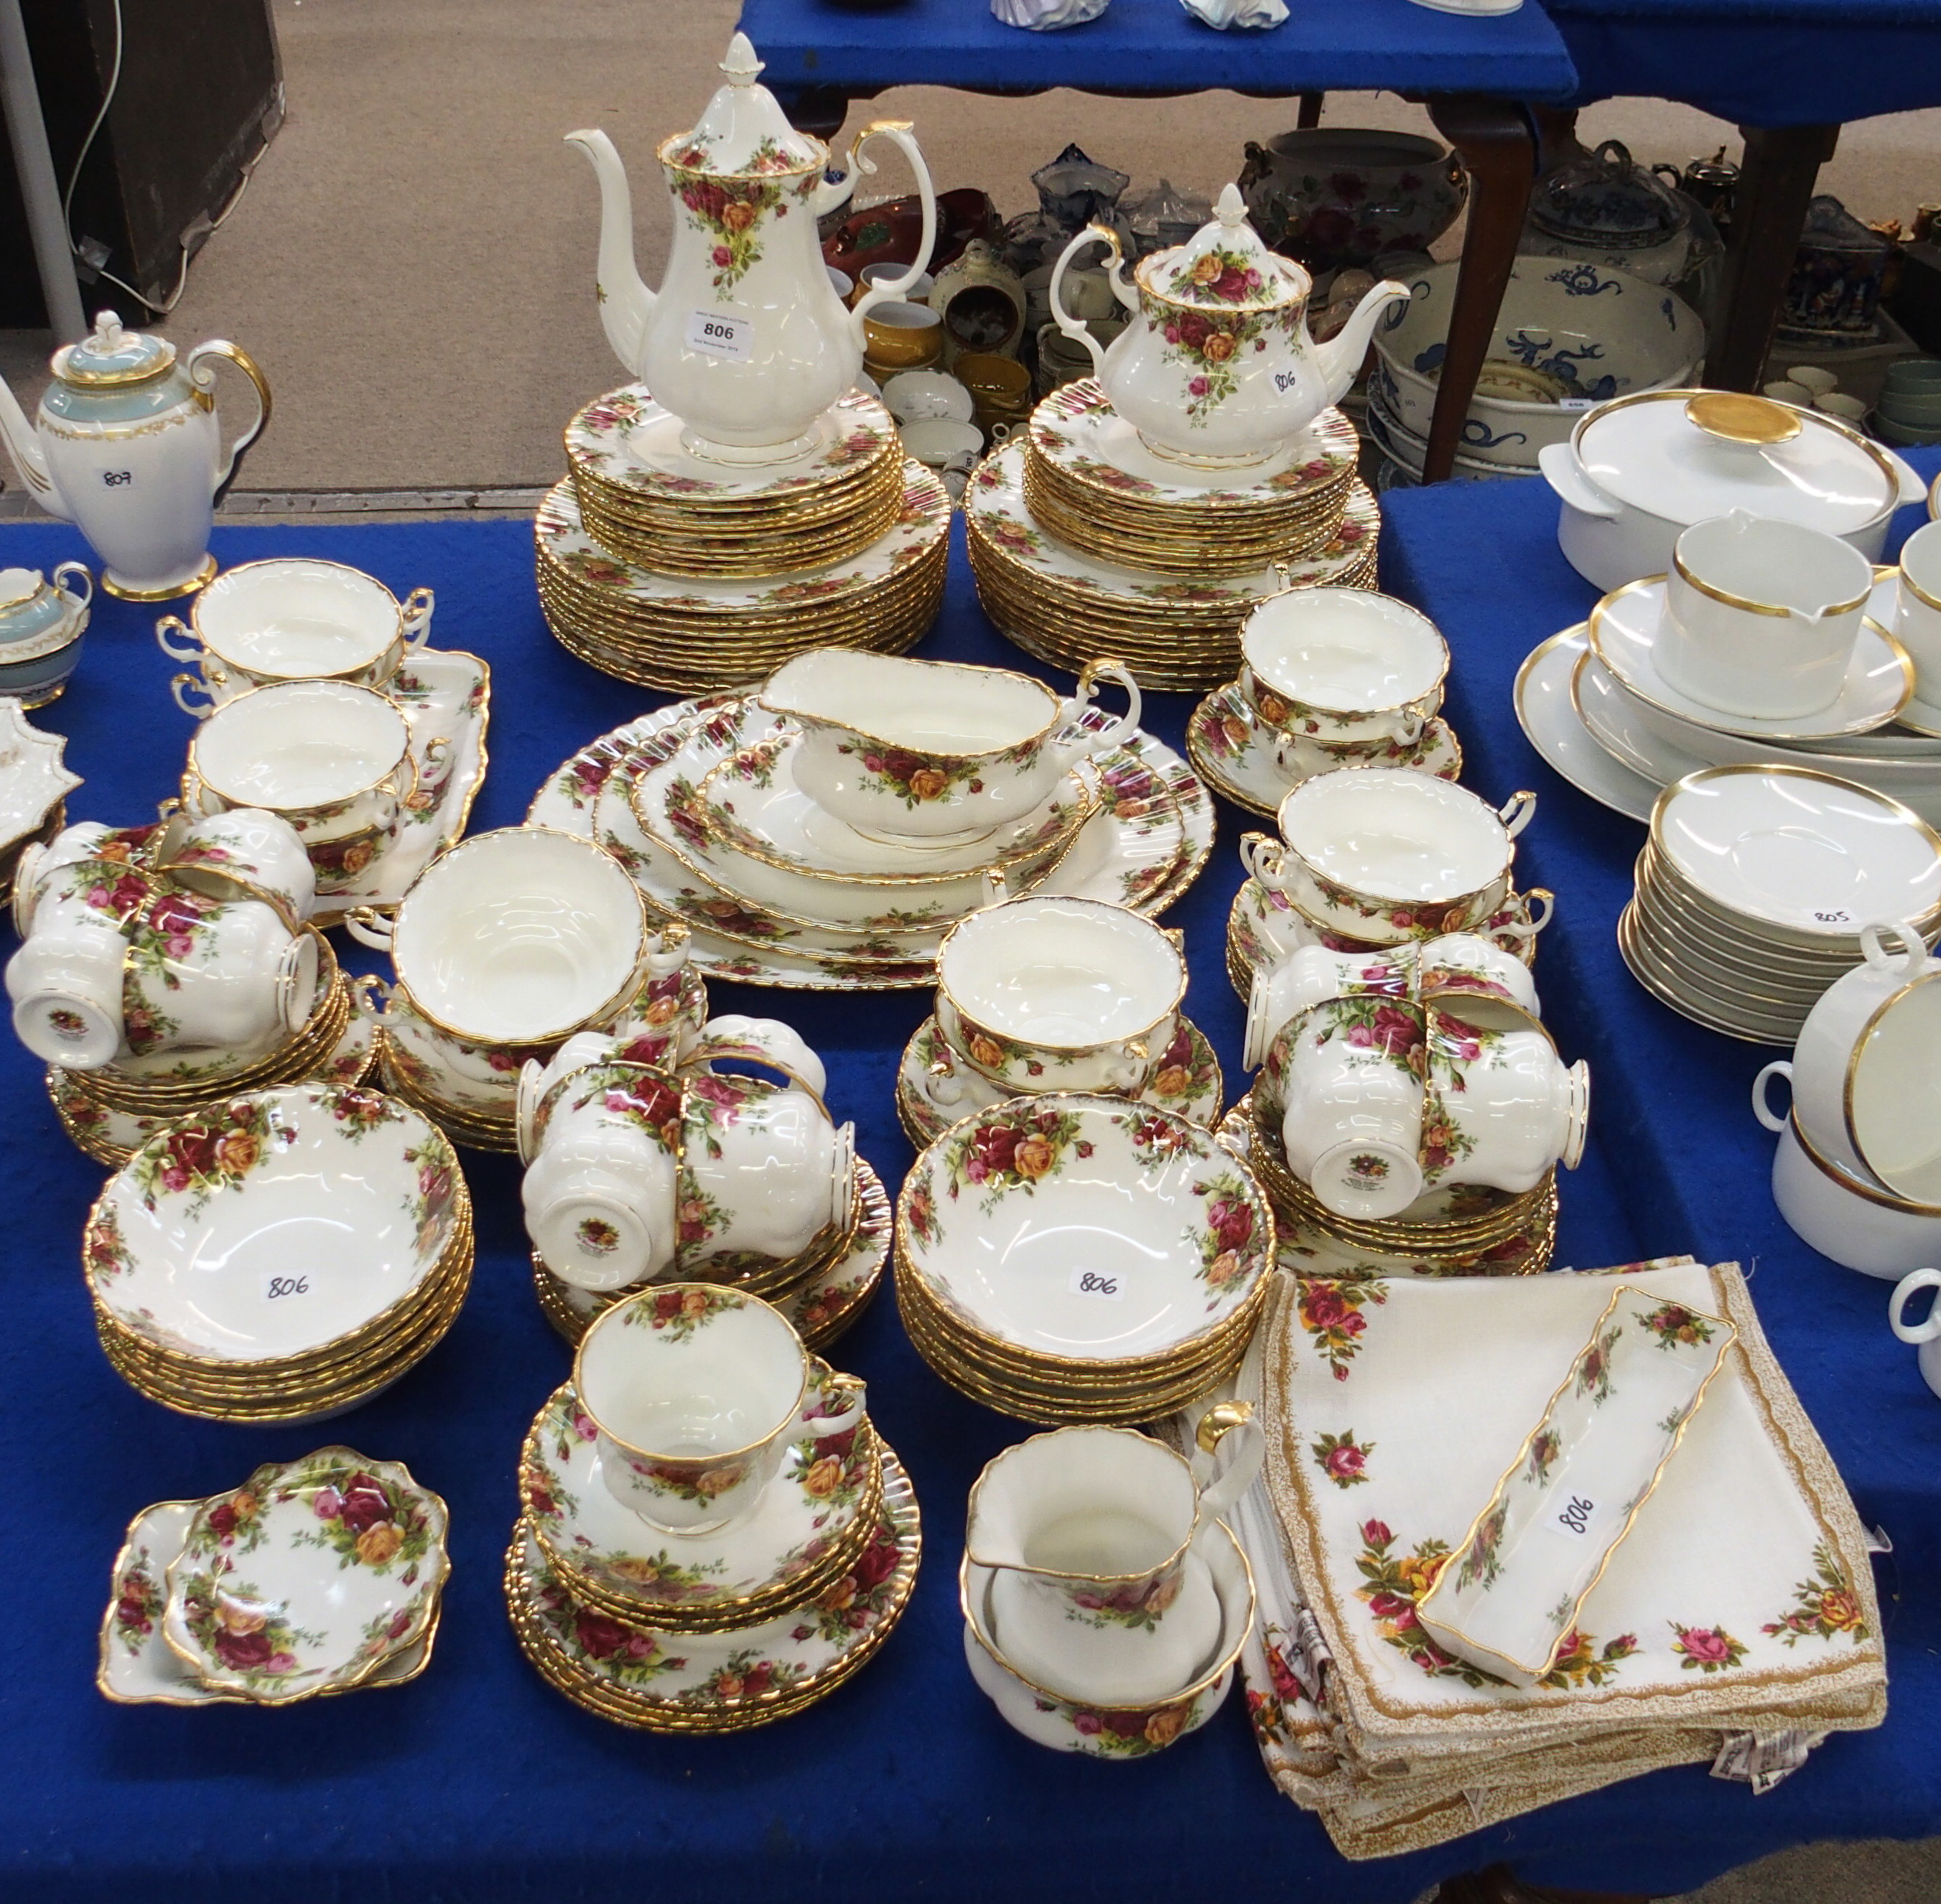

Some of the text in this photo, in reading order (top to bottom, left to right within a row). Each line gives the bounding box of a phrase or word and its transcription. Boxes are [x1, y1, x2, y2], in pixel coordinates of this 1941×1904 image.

[704, 322, 734, 340] 806
[1275, 370, 1295, 392] 806
[103, 472, 132, 486] 807
[1814, 911, 1850, 922] 805
[268, 1275, 309, 1299] 806
[1080, 1271, 1117, 1294] 806
[1559, 1495, 1593, 1534] 806
